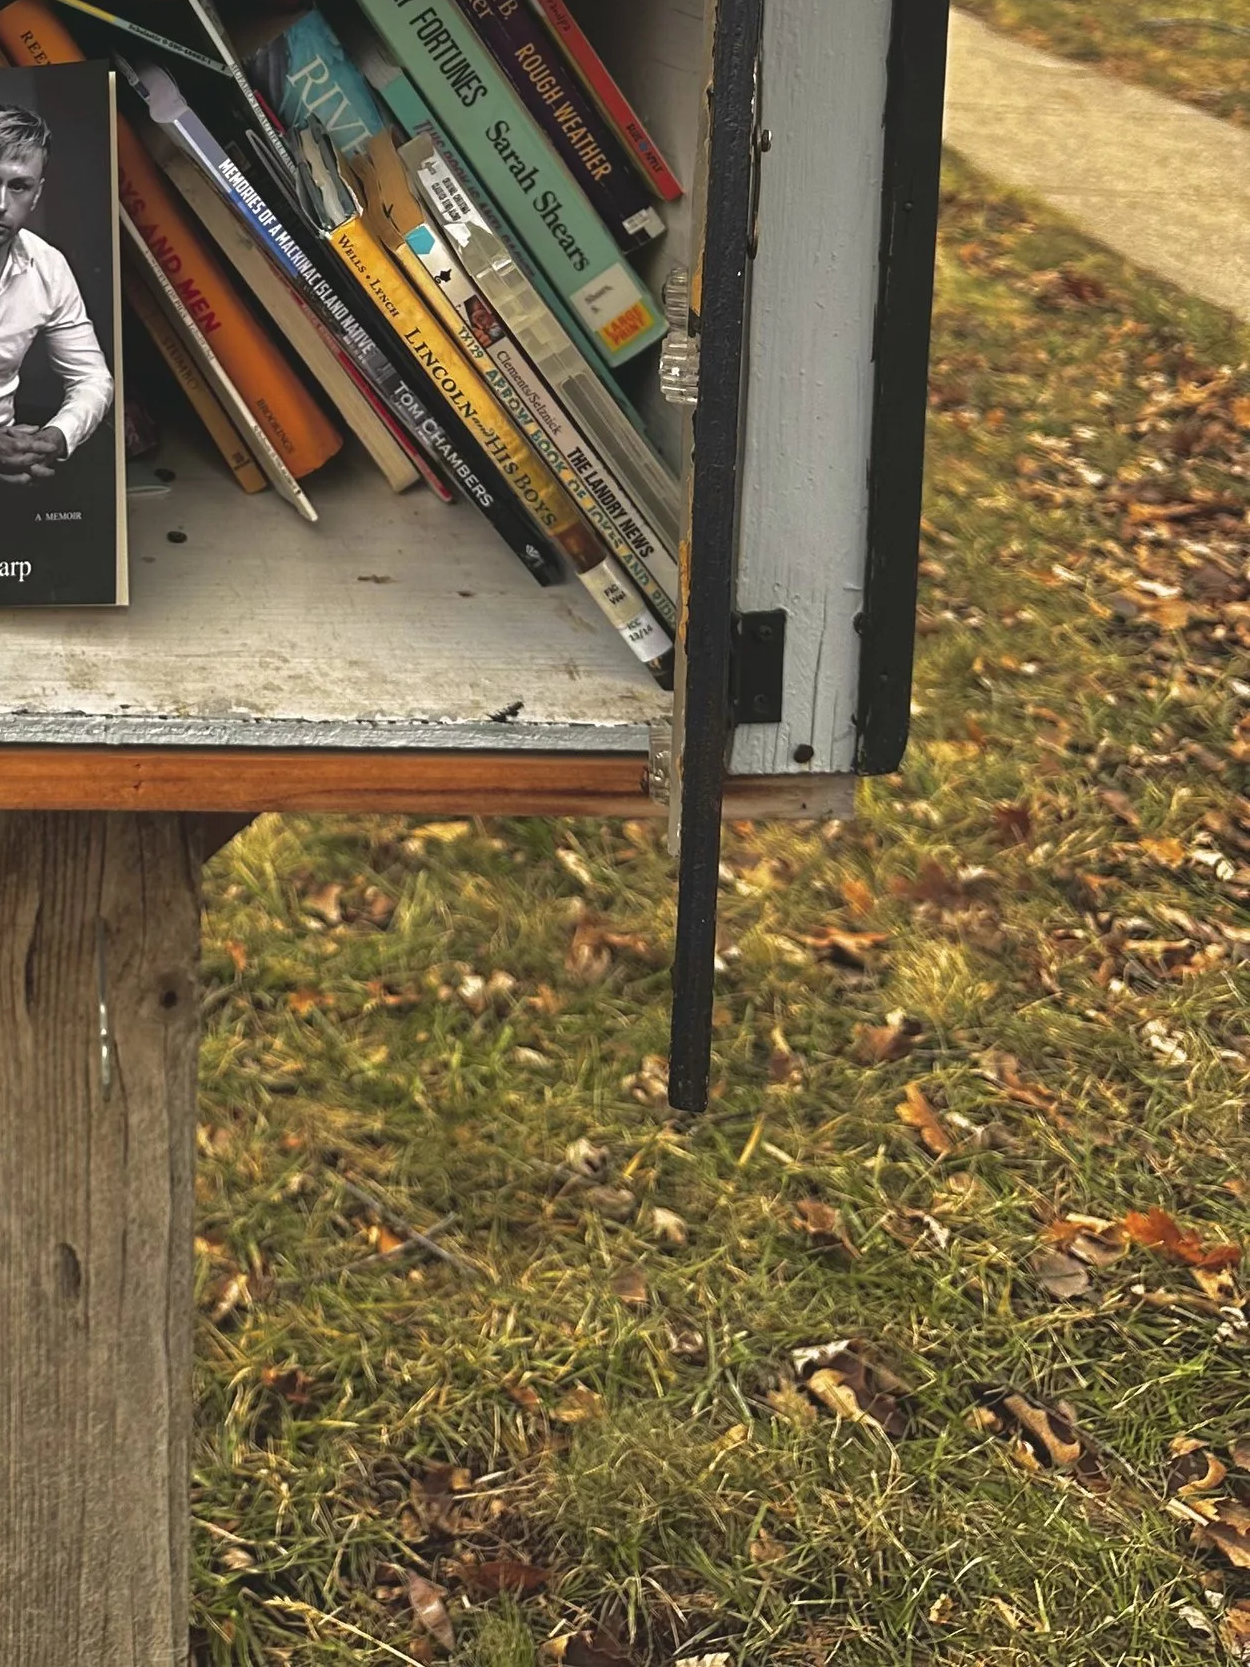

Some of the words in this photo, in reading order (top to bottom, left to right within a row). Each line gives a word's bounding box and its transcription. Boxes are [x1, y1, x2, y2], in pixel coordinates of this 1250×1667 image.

[19, 28, 50, 65] REE
[409, 7, 488, 108] FORTUNES
[485, 119, 539, 195] Sarah
[532, 190, 590, 272] Shears
[514, 41, 557, 106] ROUGH
[551, 101, 612, 182] WEATHER
[217, 157, 265, 214] MEMORIES
[257, 206, 275, 228] OF
[269, 220, 283, 238] A
[138, 223, 183, 276] AND
[178, 276, 223, 335] MEN
[274, 229, 322, 286] MACKINAC
[312, 278, 350, 321] ISLAND
[340, 313, 377, 356] NATIVE
[457, 324, 485, 360] TX129
[394, 379, 425, 421] TOM
[495, 348, 562, 436] Clements/Selznick
[254, 397, 297, 456] BROOKINGS
[404, 326, 479, 420] LINCOLN
[485, 432, 520, 476] HIS
[514, 472, 557, 527] BOYS
[421, 416, 494, 508] CHAMBERS
[34, 512, 42, 522] A
[44, 510, 82, 522] MEMOIR
[530, 429, 569, 475] BOOK
[618, 551, 651, 588] AND
[566, 444, 593, 482] THE
[584, 476, 630, 533] LANDRY
[616, 517, 656, 560] NEWS
